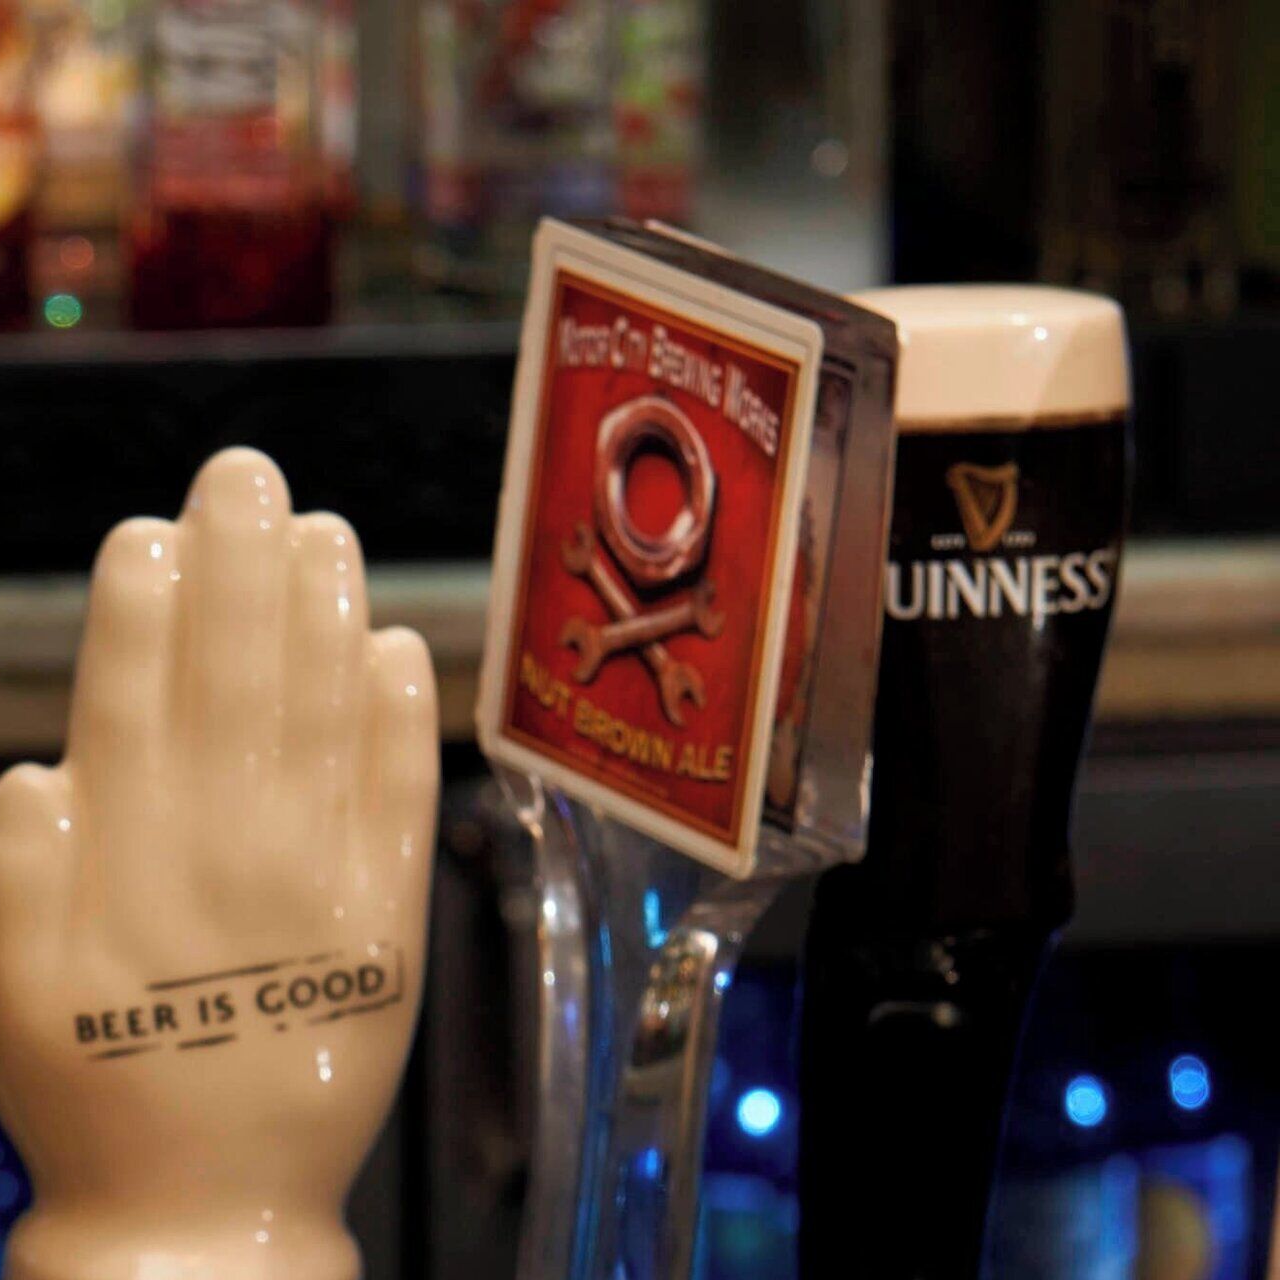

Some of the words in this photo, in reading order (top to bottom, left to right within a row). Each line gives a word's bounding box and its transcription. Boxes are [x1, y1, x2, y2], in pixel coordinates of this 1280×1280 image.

[886, 547, 1114, 621] UINNESS
[520, 653, 571, 720] NUT
[575, 698, 676, 770] BROWN
[676, 742, 734, 780] ALE
[74, 1001, 179, 1044] BEER
[197, 991, 236, 1024] IS
[255, 963, 386, 1016] GOOD
